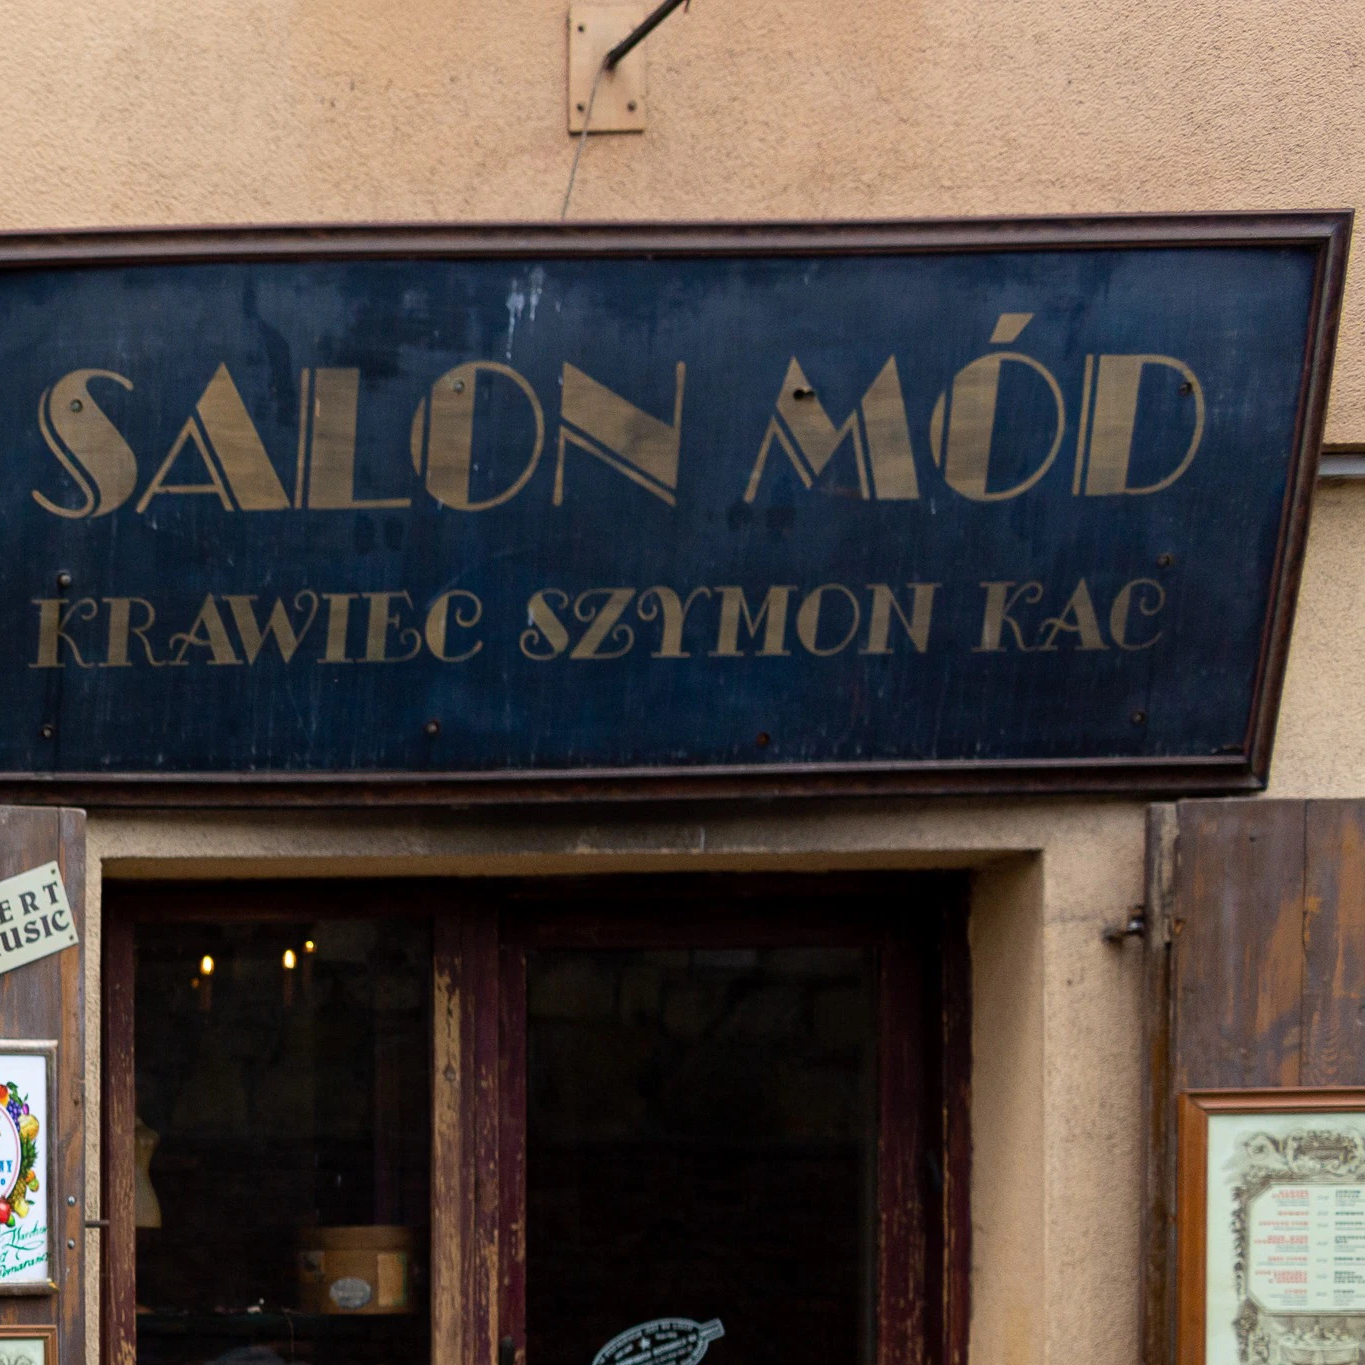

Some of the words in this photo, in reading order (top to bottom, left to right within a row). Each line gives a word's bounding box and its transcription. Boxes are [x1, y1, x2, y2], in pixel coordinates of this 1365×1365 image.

[31, 358, 687, 519] SALON
[742, 312, 1206, 507] MÓD
[27, 588, 485, 669] KRAWIEC
[517, 580, 941, 661] SZYMON
[971, 578, 1167, 653] KAC
